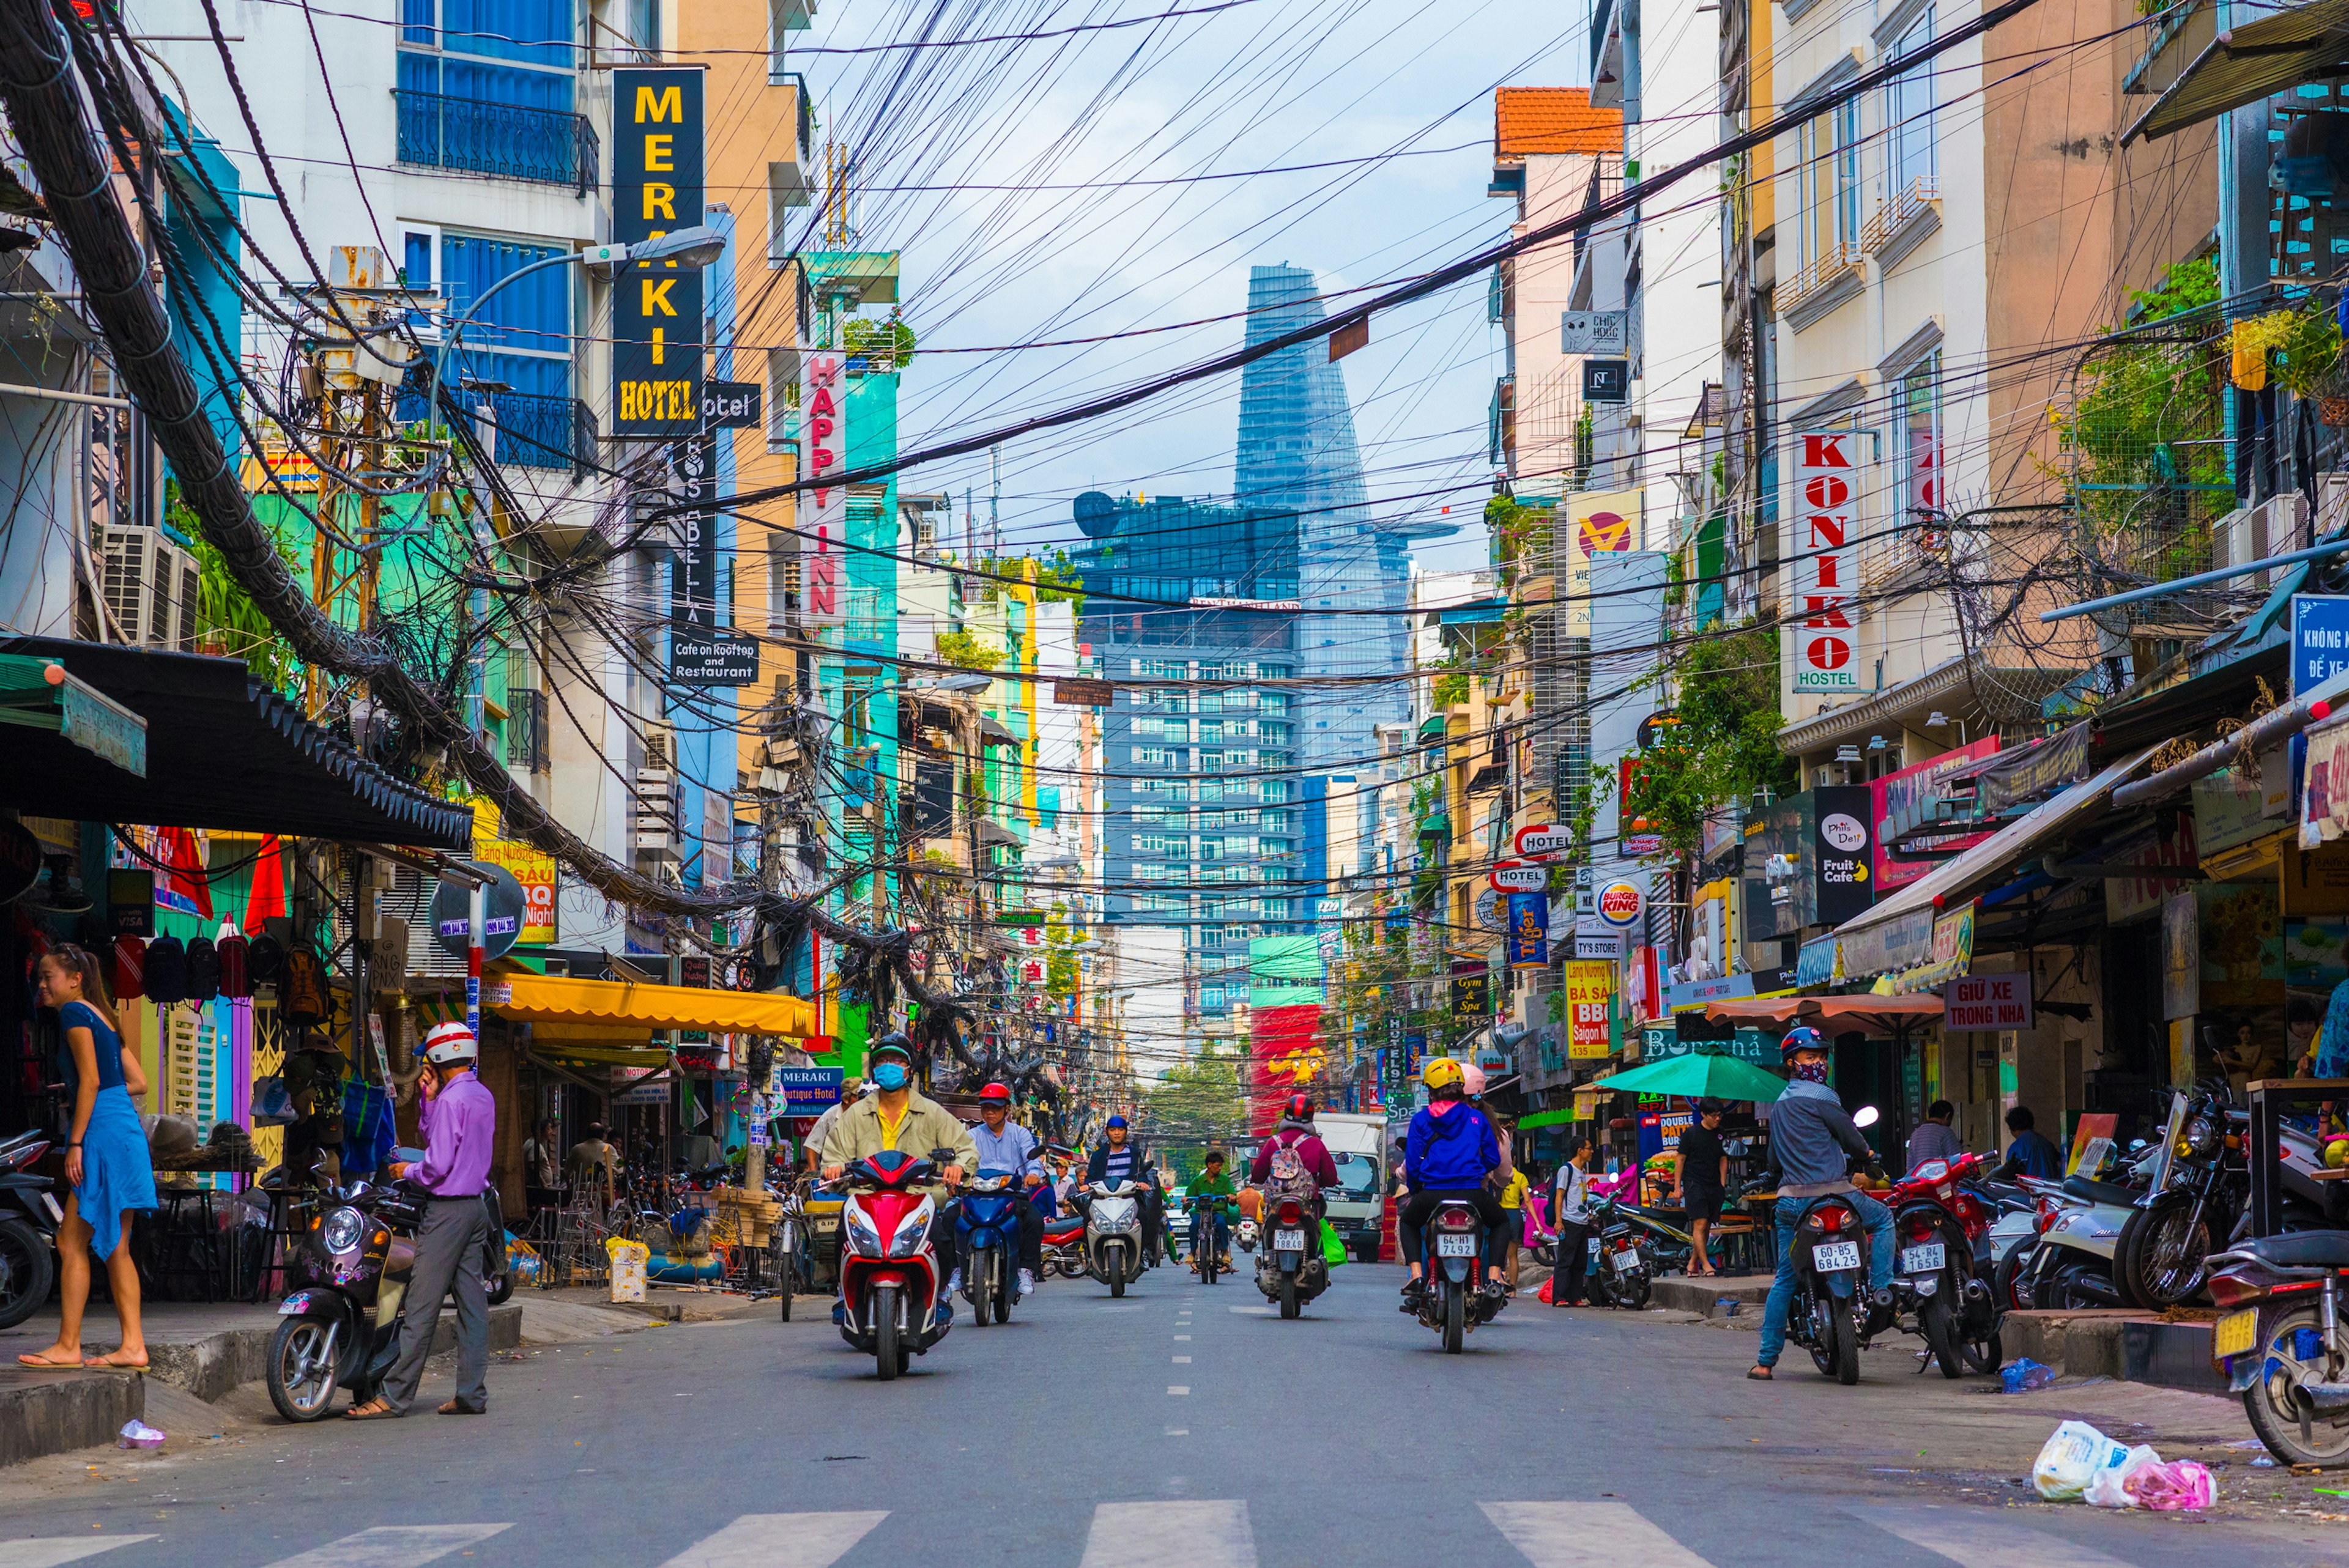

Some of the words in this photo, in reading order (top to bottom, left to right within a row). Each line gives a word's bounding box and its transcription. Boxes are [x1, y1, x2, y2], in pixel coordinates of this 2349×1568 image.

[620, 380, 696, 421] HOTEL
[811, 358, 836, 508] HAPPY
[1801, 435, 1852, 670] KONIKO
[810, 526, 835, 614] INN
[2304, 627, 2341, 648] KHÔNG
[675, 643, 698, 656] Cafe
[700, 647, 712, 656] on
[713, 643, 754, 659] Rooftop
[705, 657, 724, 665] and
[676, 666, 753, 678] Restaurant
[1799, 672, 1857, 687] HOSTEL
[1526, 837, 1571, 847] HOTEL
[1838, 834, 1861, 843] Deli
[1824, 859, 1854, 871] Fruit
[513, 865, 553, 882] SÁU
[1500, 871, 1542, 880] HOTEL
[1824, 871, 1854, 882] Cafe
[1603, 892, 1639, 901] BURGER
[1601, 900, 1639, 913] KING
[119, 917, 143, 926] VISA
[526, 906, 554, 927] Night
[1518, 908, 1543, 958] Tiger
[1597, 943, 1616, 953] STORE
[374, 953, 401, 971] RNG
[373, 970, 398, 988] PNX
[1458, 977, 1482, 989] Gym
[1466, 990, 1474, 1000] &
[1570, 985, 1587, 1000] BÀ
[1958, 978, 1986, 1002] GIỮ
[1991, 982, 2012, 1000] XE
[1460, 1001, 1480, 1012] Spa
[1950, 1006, 1994, 1025] TRONG
[1998, 1003, 2025, 1023] NHÀ
[1573, 1024, 1599, 1045] Saigon
[1572, 1047, 1588, 1056] 135
[784, 1073, 831, 1082] MERAKI
[814, 1087, 836, 1099] Hotel
[1388, 1104, 1417, 1120] Spa
[1660, 1115, 1694, 1127] DOUBLE
[1279, 1231, 1299, 1240] 59-P1
[1444, 1236, 1469, 1244] 64-H1
[1444, 1245, 1470, 1254] 7492
[1820, 1244, 1850, 1258] 60-B5
[1909, 1246, 1938, 1260] 54-R4
[1819, 1256, 1857, 1270] 684.25
[1910, 1257, 1939, 1272] 1656
